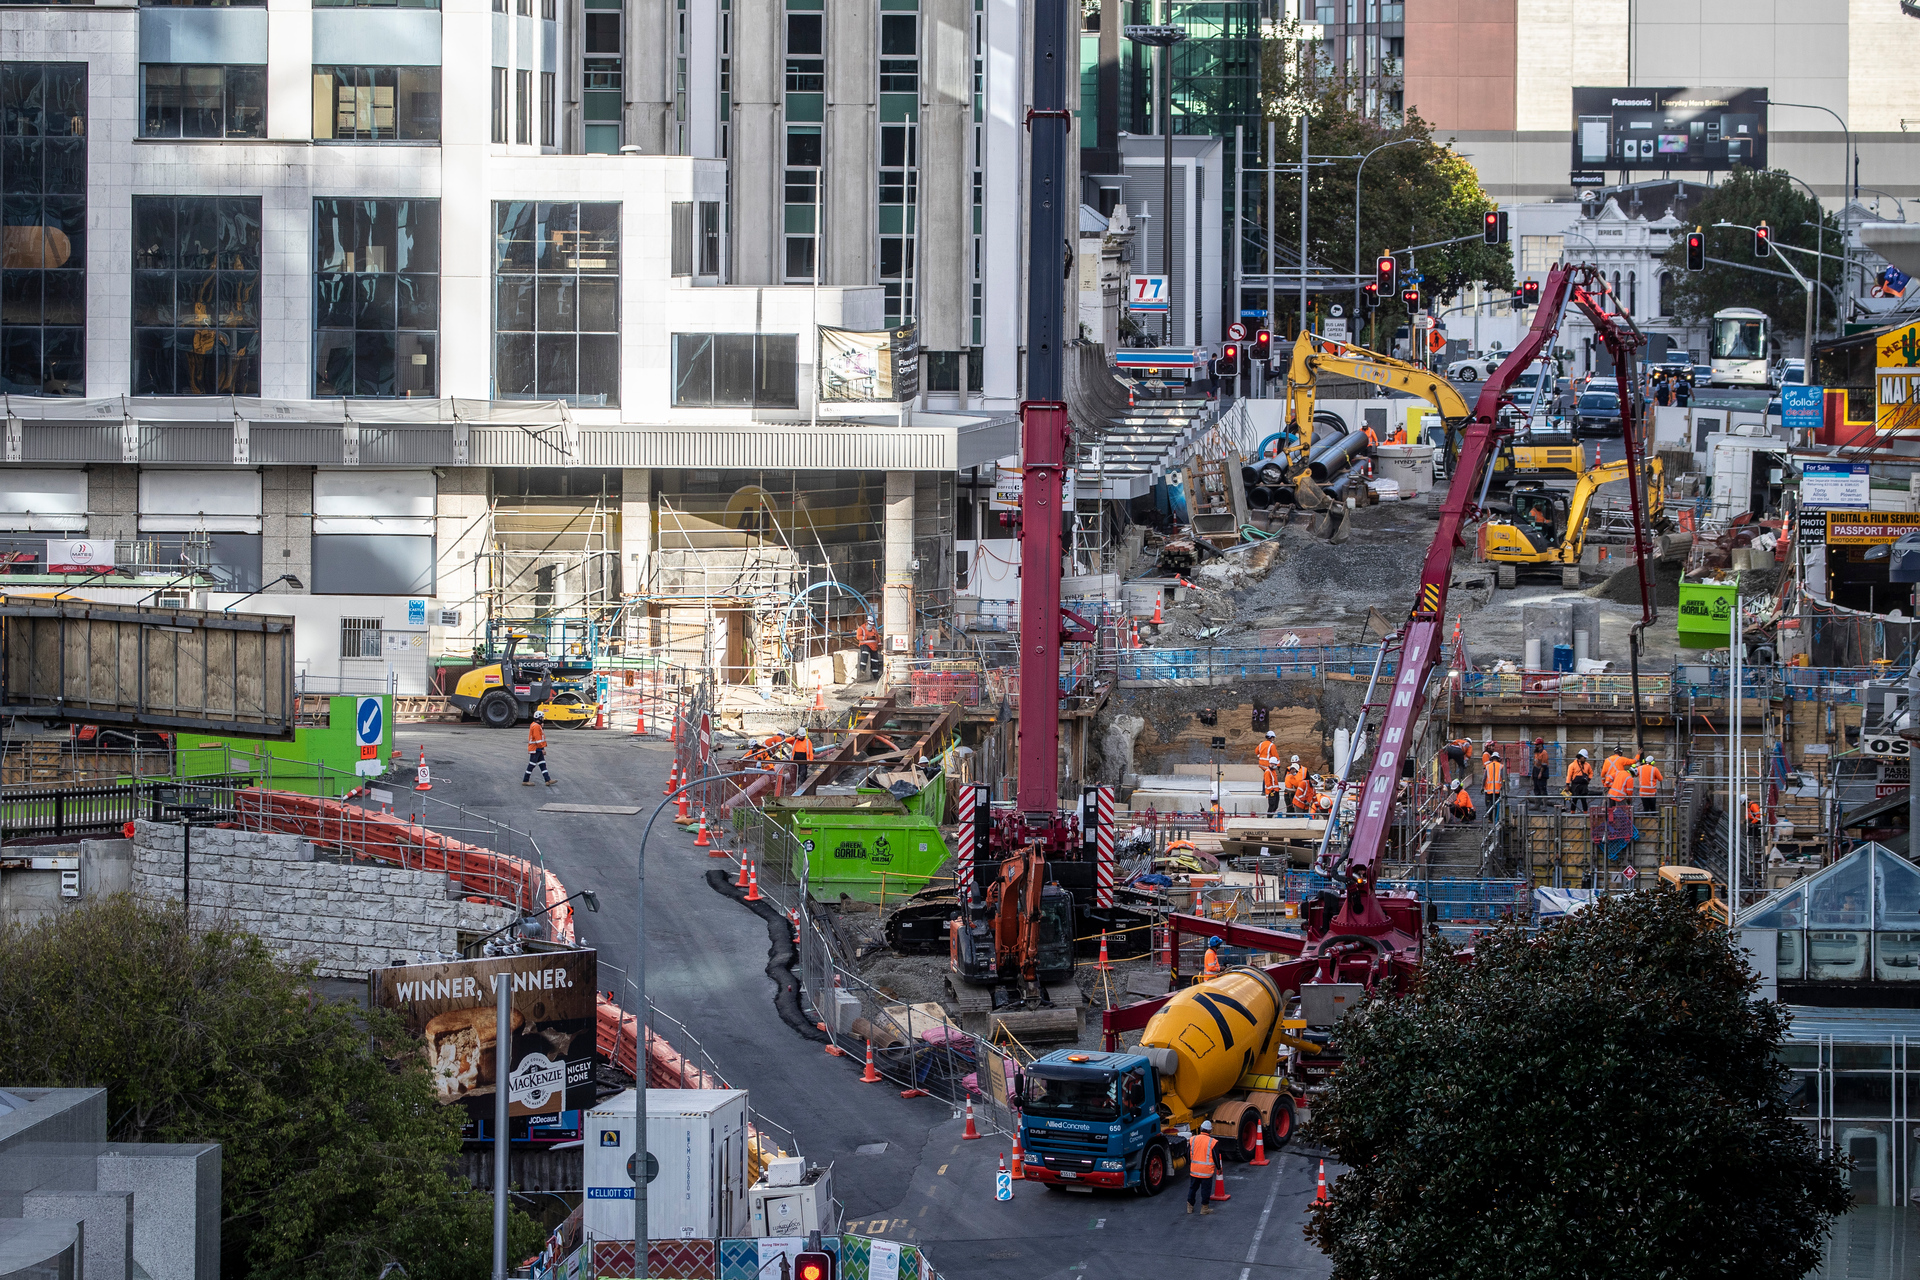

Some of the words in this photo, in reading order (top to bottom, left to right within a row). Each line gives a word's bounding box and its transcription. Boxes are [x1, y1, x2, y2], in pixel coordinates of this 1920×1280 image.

[1612, 98, 1652, 106] Panasonic
[1136, 278, 1162, 298] 77
[1881, 376, 1906, 404] MAI
[1790, 398, 1815, 406] dollar
[1786, 408, 1820, 416] dealers
[1831, 514, 1861, 523] DIGITAL
[1870, 514, 1889, 523] FILM
[1834, 526, 1883, 535] PASSPORT
[1887, 527, 1920, 535] PHOTO
[1395, 646, 1420, 707] IAN
[362, 747, 376, 756] EXIT
[1368, 728, 1402, 818] HOWE
[834, 848, 867, 858] GORILLA
[396, 976, 483, 1002] WINNER,
[489, 968, 573, 994] WNNER.
[567, 1062, 592, 1074] NICELY
[568, 1072, 588, 1083] DONE
[528, 1116, 557, 1124] JCDecaux
[1063, 1122, 1090, 1130] Concrete
[595, 1189, 621, 1197] ELLIOTT
